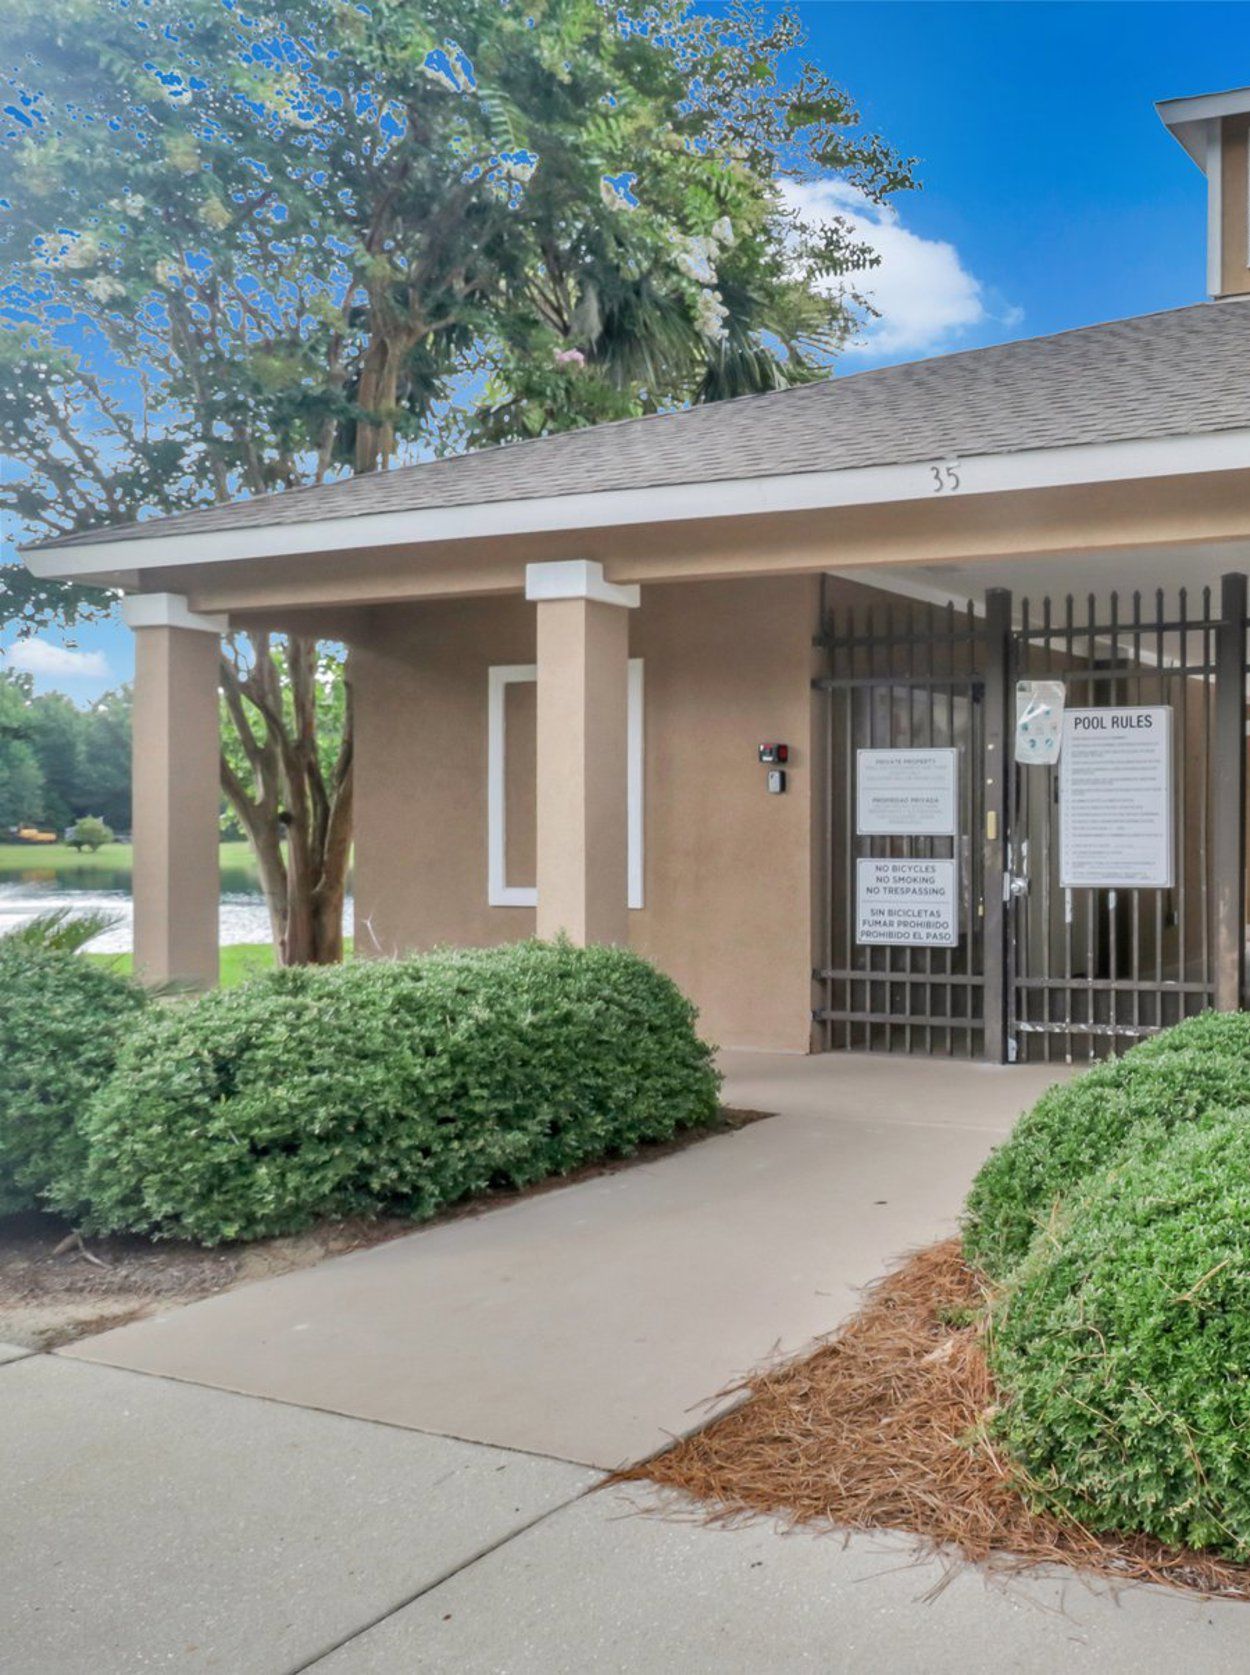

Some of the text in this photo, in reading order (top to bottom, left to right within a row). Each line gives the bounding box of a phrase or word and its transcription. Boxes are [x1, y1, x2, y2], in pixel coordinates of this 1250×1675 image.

[930, 465, 960, 492] 35
[1074, 714, 1153, 730] POOL RULES
[875, 864, 936, 873] NO BICYCLES
[876, 876, 935, 884] NO SMOKING
[866, 887, 945, 896] NO TRESPASSING
[870, 908, 941, 918] SIN BICICLETAS
[862, 919, 949, 930] FUMAR PROHIBIDO
[860, 930, 951, 941] PROHIBIDO EL PASO
